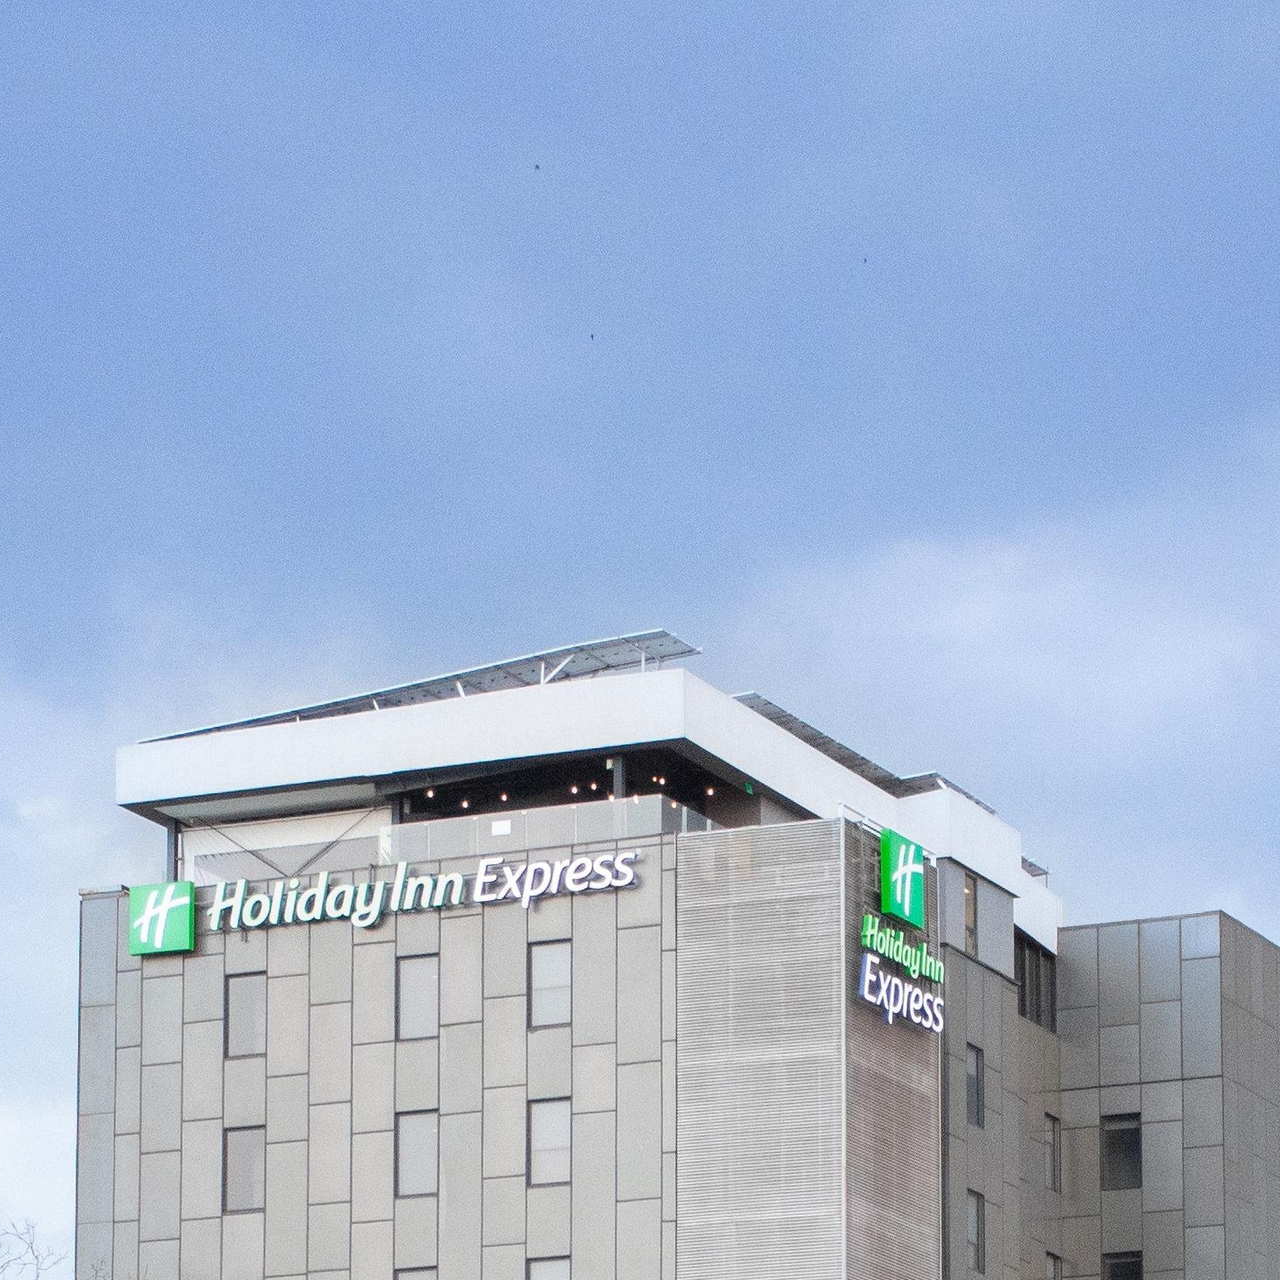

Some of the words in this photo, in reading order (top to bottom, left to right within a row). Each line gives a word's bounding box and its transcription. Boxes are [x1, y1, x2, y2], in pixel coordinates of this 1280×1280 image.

[207, 871, 386, 930] Holiday
[390, 861, 463, 912] Inn
[472, 852, 637, 909] Express
[862, 914, 921, 979] Holiday
[920, 942, 944, 984] Inn
[861, 953, 945, 1034] Express
